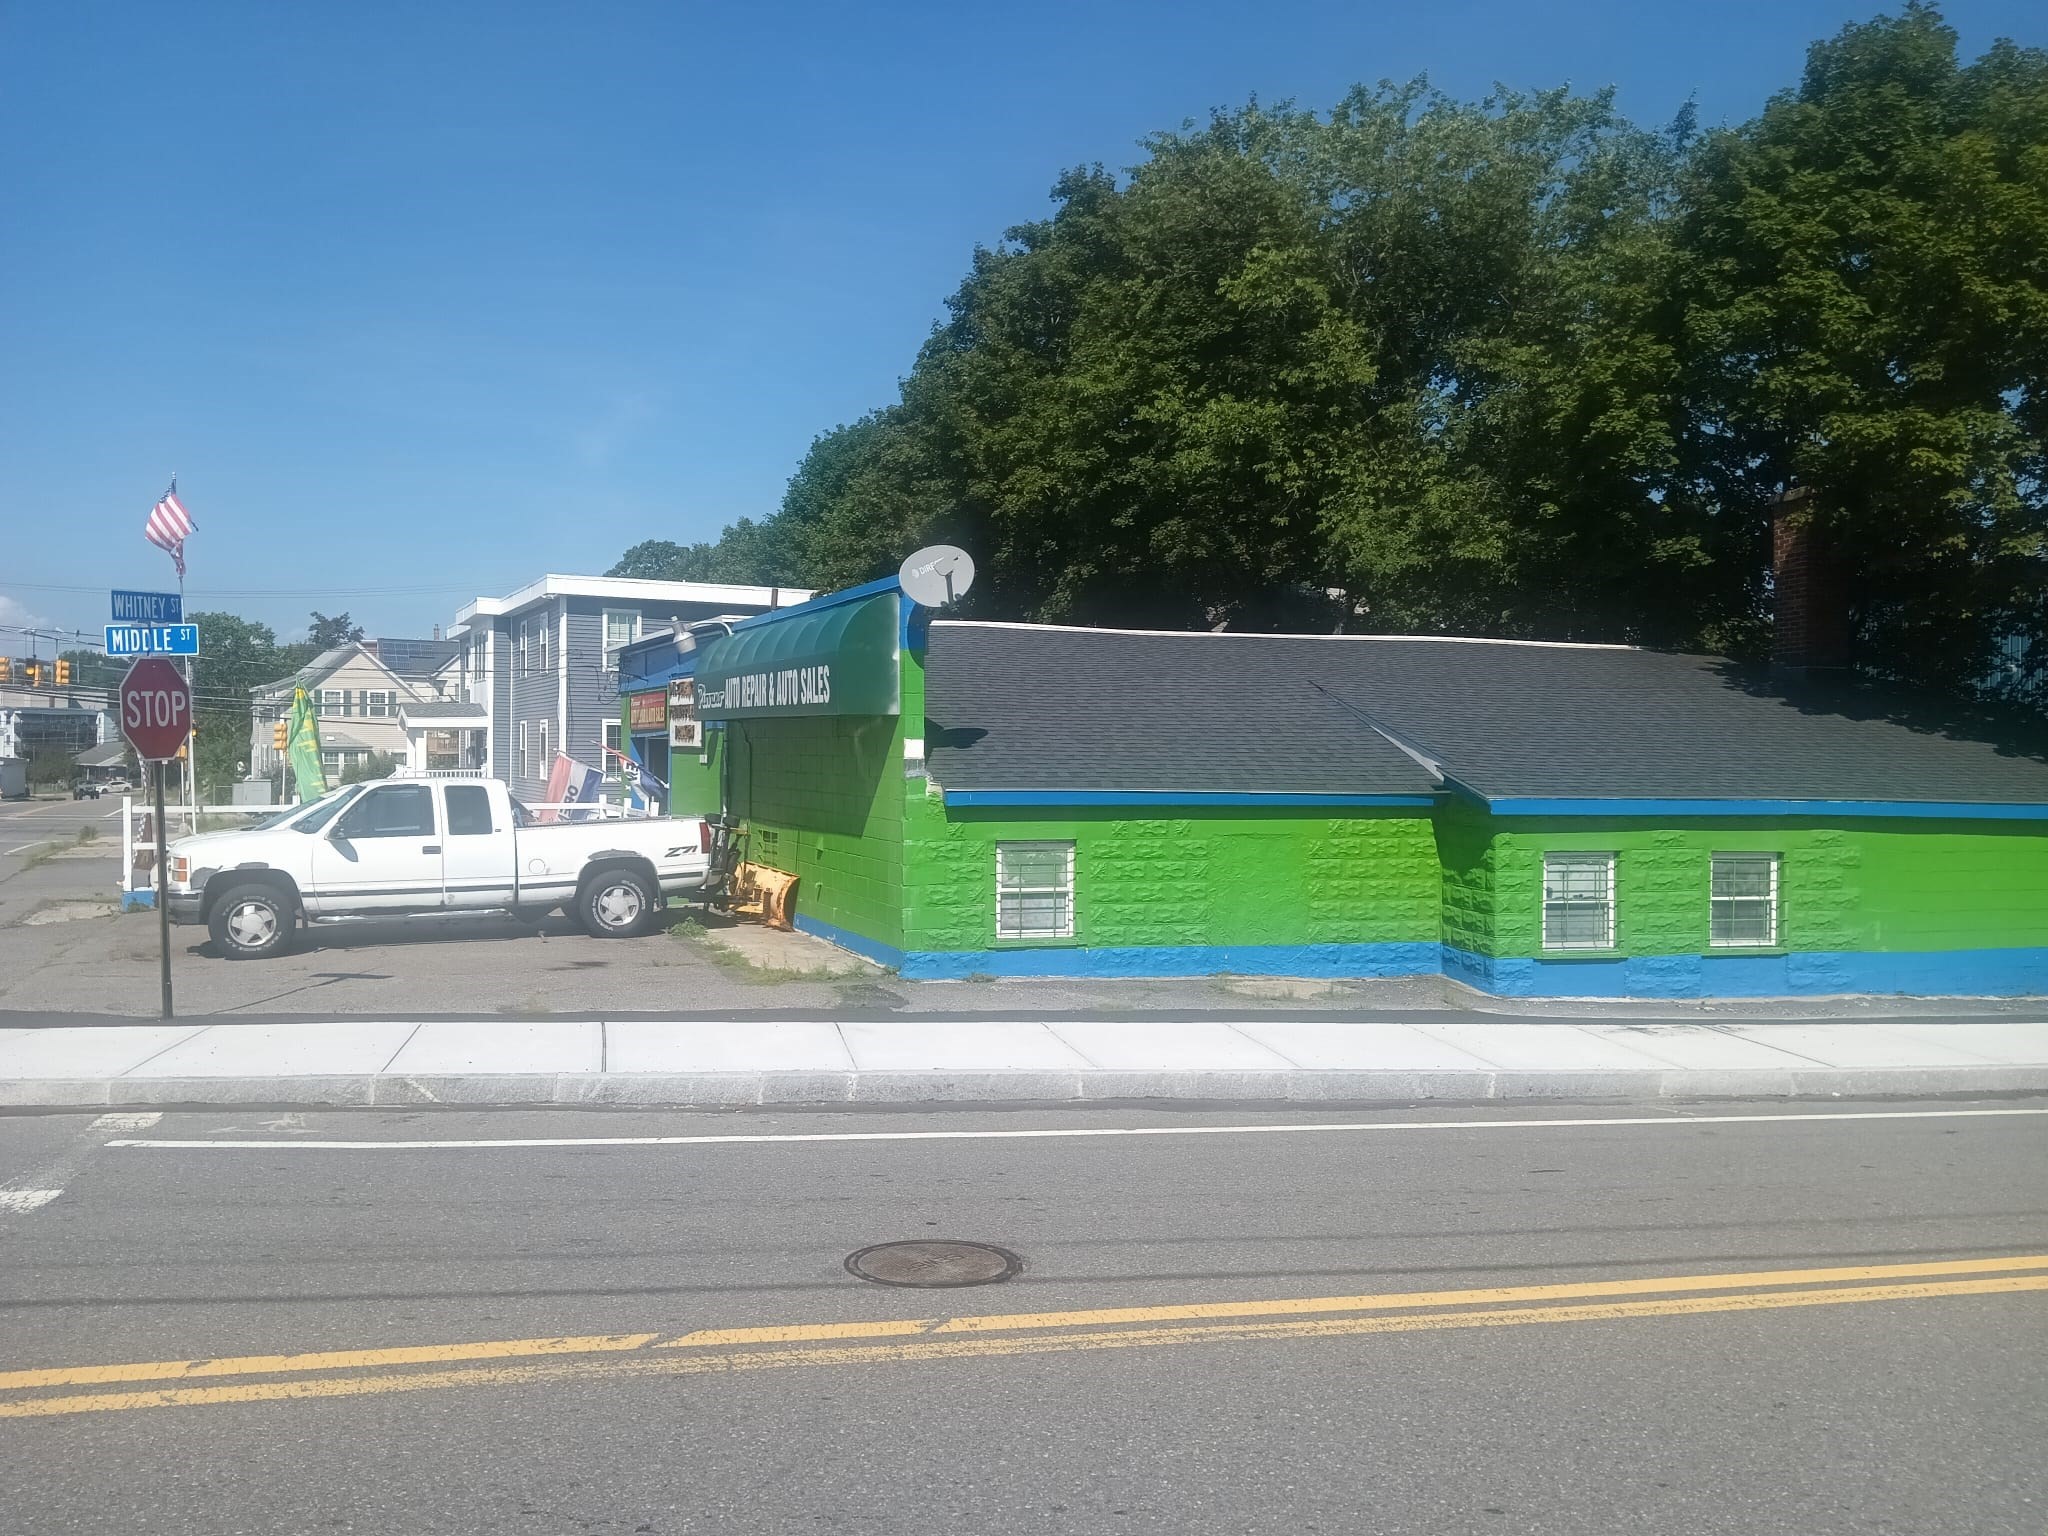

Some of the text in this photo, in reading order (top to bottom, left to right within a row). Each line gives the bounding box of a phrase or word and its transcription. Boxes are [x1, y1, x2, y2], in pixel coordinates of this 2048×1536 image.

[113, 594, 165, 619] WHITNEY
[112, 628, 191, 652] MIDDLE ST
[724, 676, 740, 709] AUTO
[741, 673, 767, 708] REPAIR
[768, 671, 775, 707] &
[776, 668, 799, 706] AUTO
[800, 664, 830, 705] SALES
[126, 690, 186, 729] STOP
[664, 844, 698, 858] Z71
